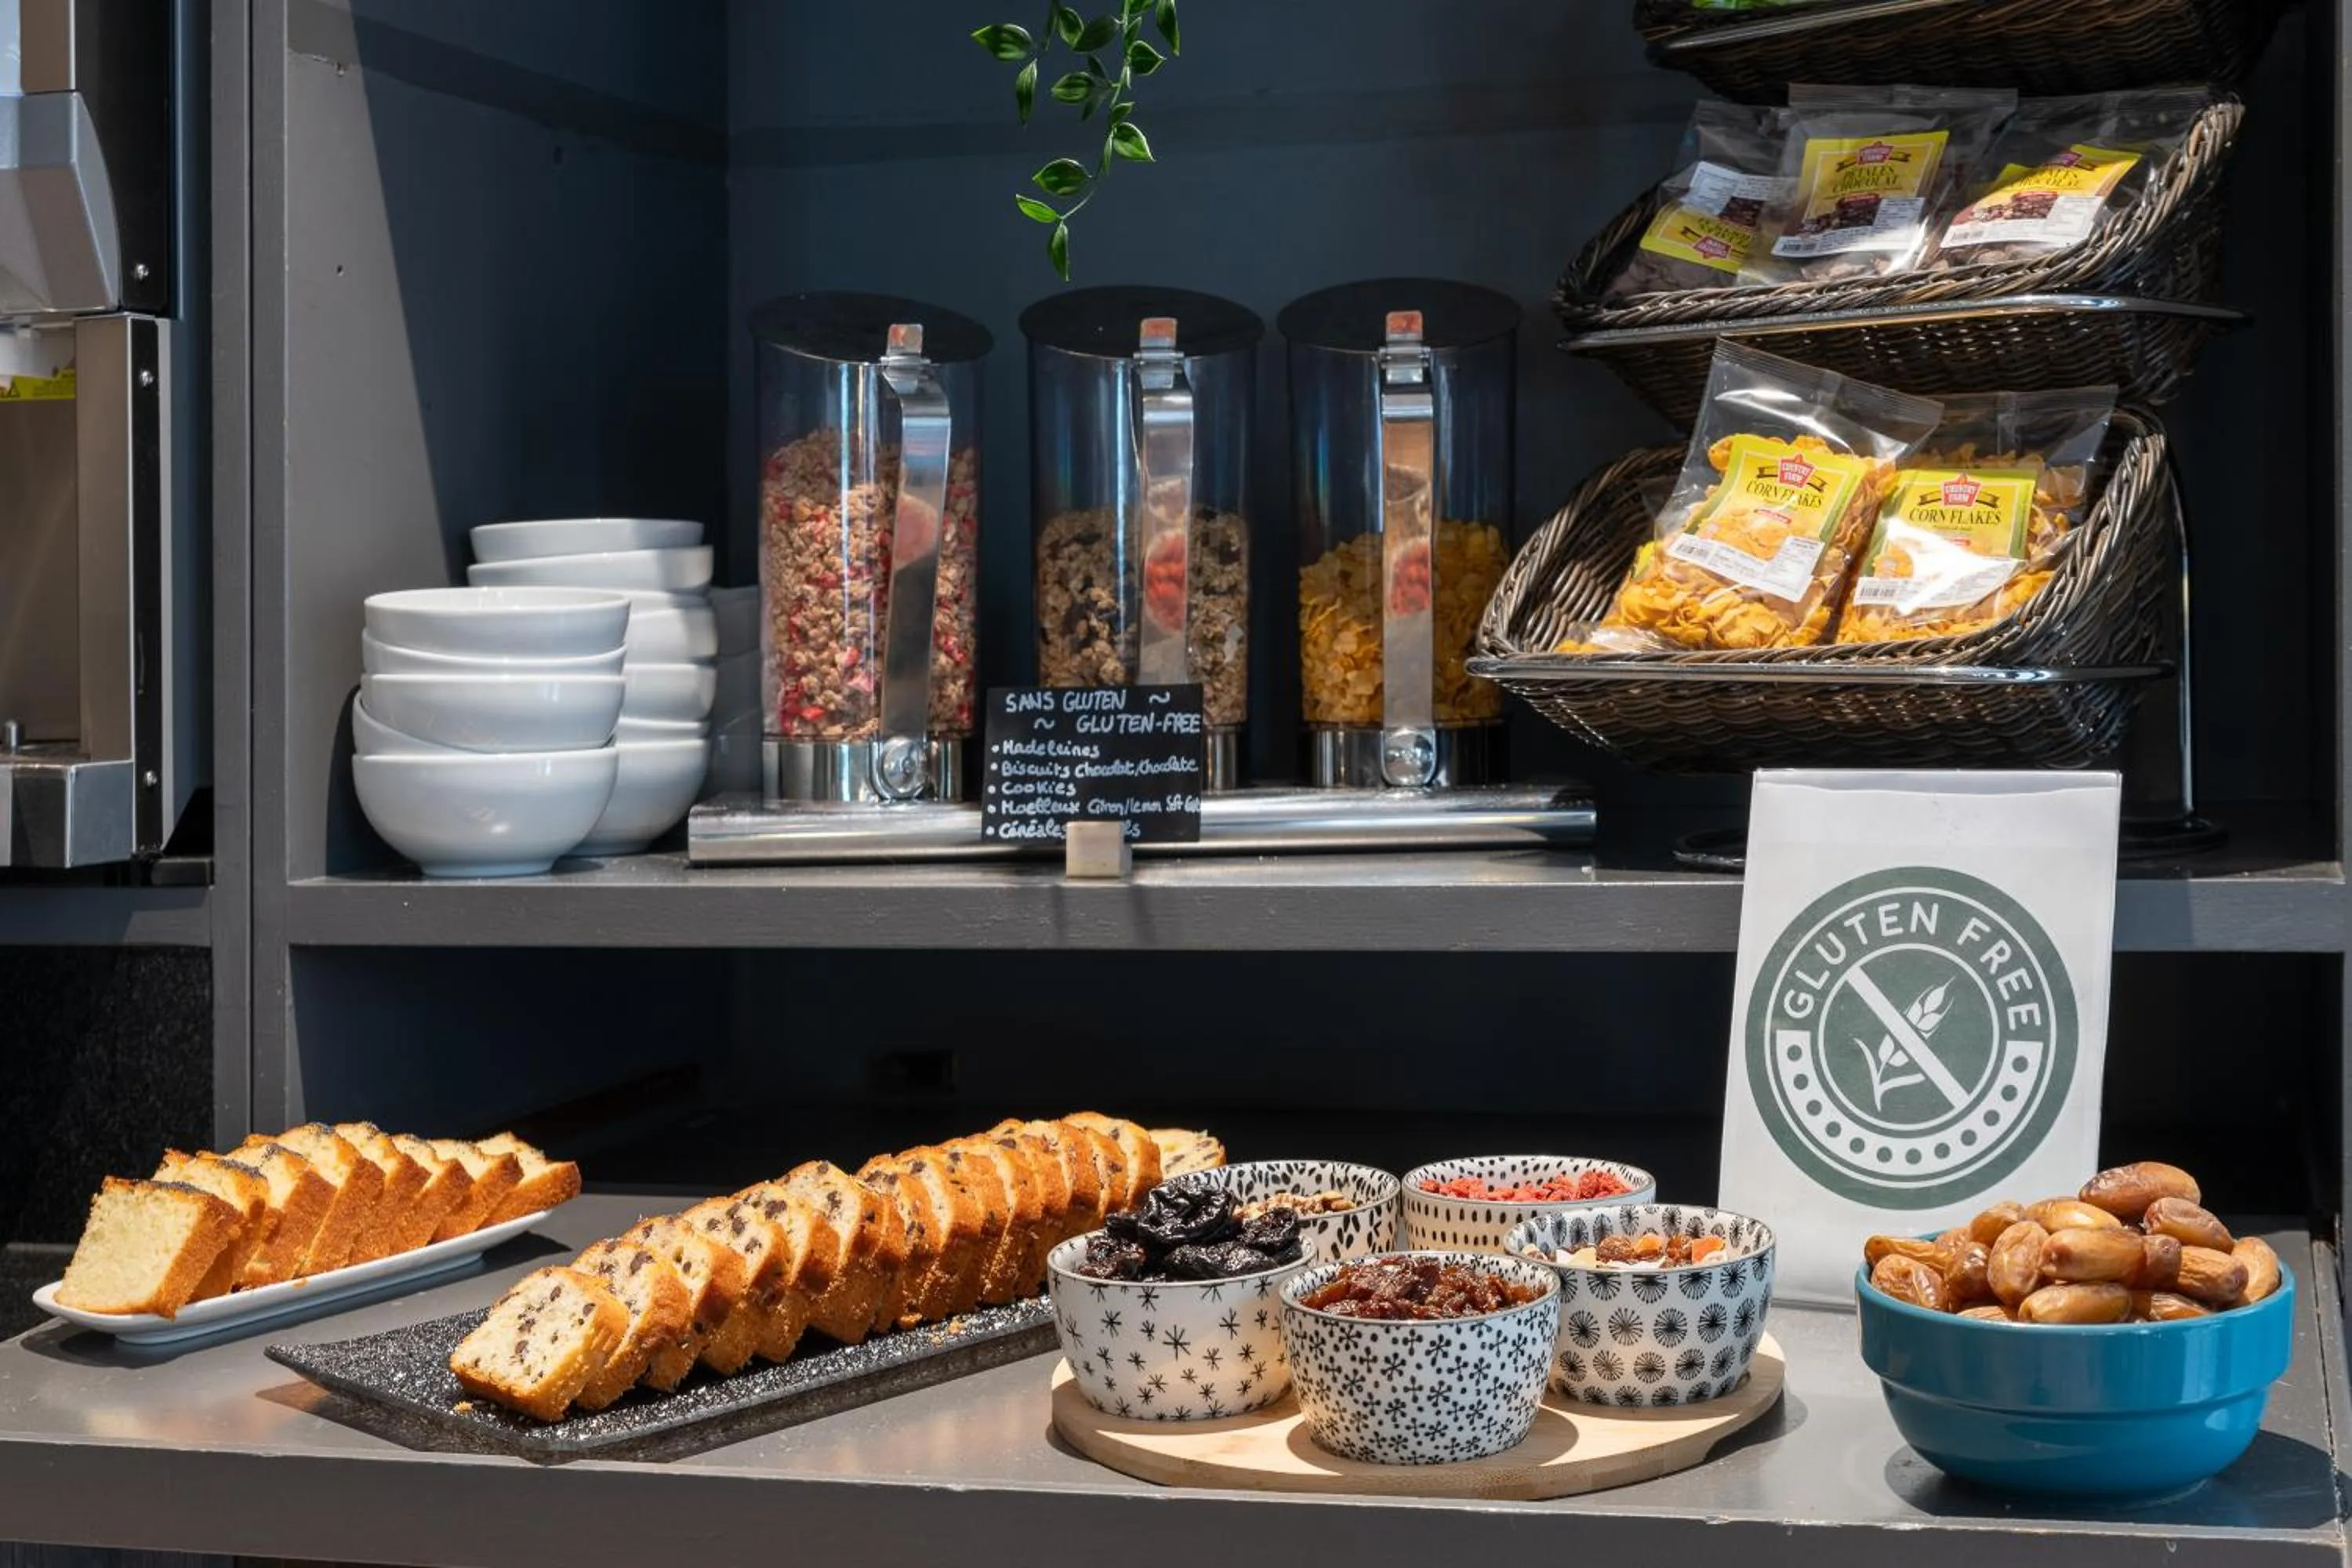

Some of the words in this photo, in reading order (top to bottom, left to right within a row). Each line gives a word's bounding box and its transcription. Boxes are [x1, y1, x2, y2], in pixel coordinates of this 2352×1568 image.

[1746, 479, 1781, 499] CORN
[1909, 508, 1948, 523] CORN
[1950, 509, 2002, 524] FLAKES
[1005, 691, 1054, 713] SANS
[1062, 689, 1127, 712] GLUTEN
[1076, 712, 1202, 734] GLUTEN-FREE
[1002, 739, 1101, 758] Madeleines
[1001, 760, 1071, 779] Biscuits
[1001, 797, 1080, 815] Moelleux
[1784, 902, 1940, 1019] GLUTEN
[1957, 916, 2042, 1032] FREE
